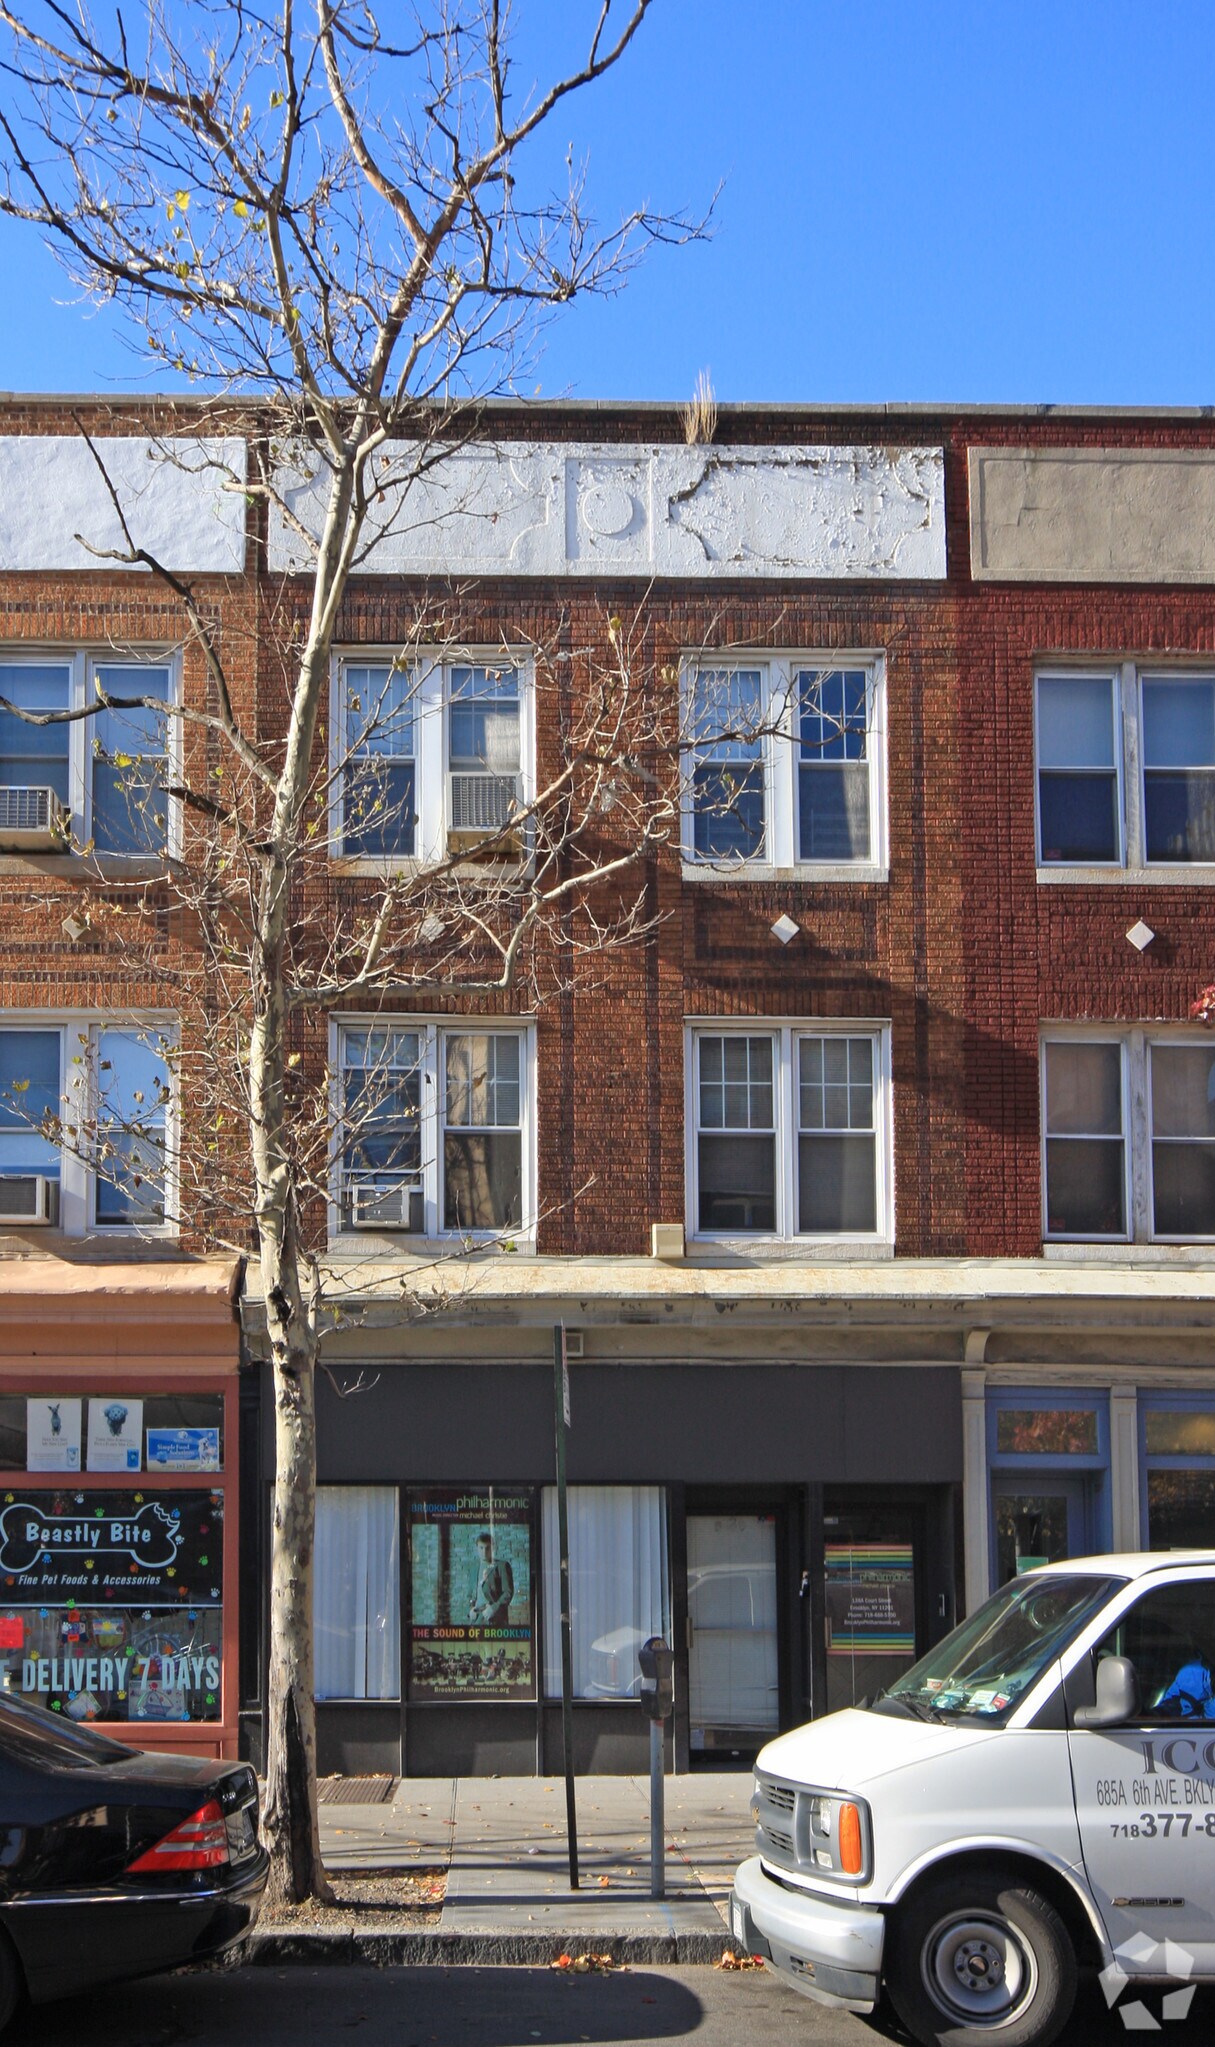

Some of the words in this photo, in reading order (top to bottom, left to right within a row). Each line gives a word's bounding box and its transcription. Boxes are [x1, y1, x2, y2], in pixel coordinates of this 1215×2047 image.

[411, 1503, 456, 1512] BROOKLYN
[456, 1495, 529, 1512] philharmonic
[459, 1511, 484, 1519] michael
[26, 1522, 101, 1548] Beastly
[110, 1522, 152, 1543] Bite
[18, 1574, 39, 1585] Fine
[41, 1574, 59, 1585] Pet
[60, 1574, 89, 1585] Foods
[91, 1574, 100, 1585] &
[102, 1574, 161, 1585] Accessories
[412, 1628, 430, 1638] THE
[433, 1628, 465, 1638] SOUND
[468, 1628, 481, 1638] OF
[484, 1628, 532, 1638] BROOKLYN
[22, 1658, 129, 1692] DELIVERY
[139, 1658, 151, 1690] 7
[161, 1657, 220, 1691] DAYS
[434, 1686, 510, 1694] BrooklynPhilharmonic.org
[1096, 1779, 1128, 1806] 685A
[1132, 1779, 1151, 1806] 6th
[1154, 1779, 1182, 1806] AVE.
